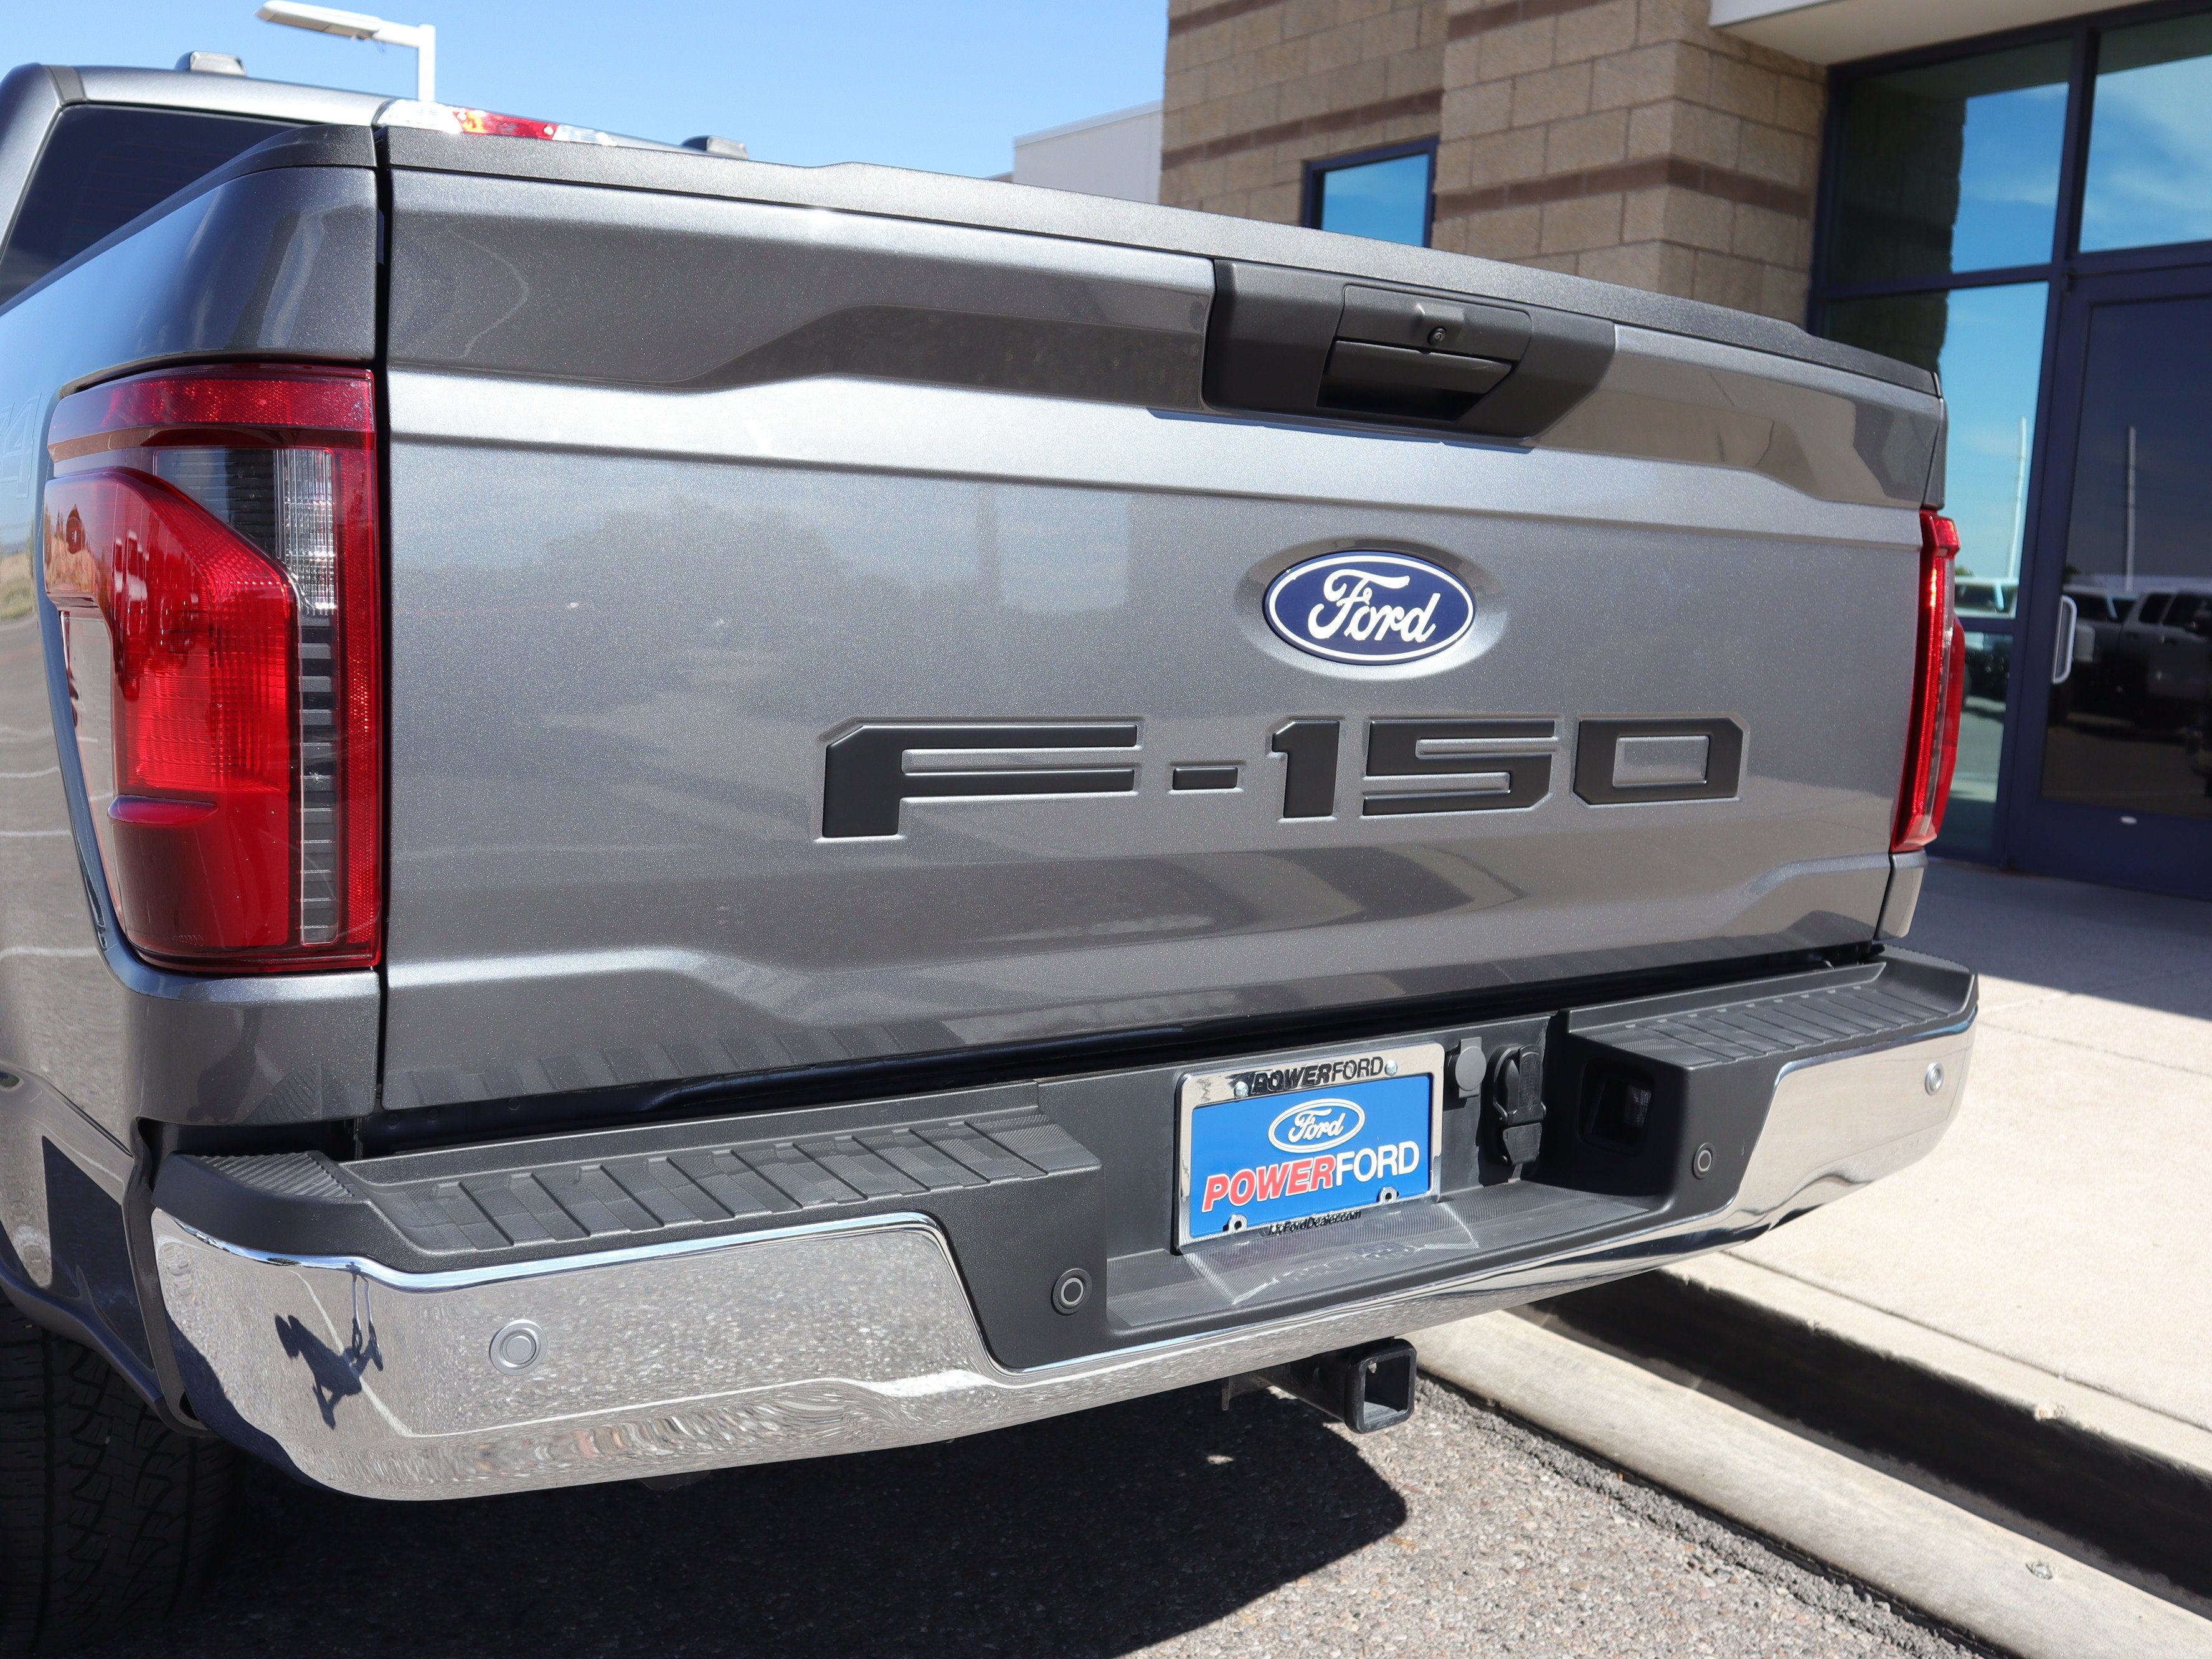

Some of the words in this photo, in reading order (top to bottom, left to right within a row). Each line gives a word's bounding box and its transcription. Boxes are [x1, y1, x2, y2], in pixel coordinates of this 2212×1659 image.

[1308, 568, 1441, 643] Ford
[820, 717, 1744, 839] F-150
[1250, 1056, 1384, 1095] POWERFORD
[1287, 1108, 1346, 1143] Ford
[1201, 1140, 1420, 1213] POWERFORD
